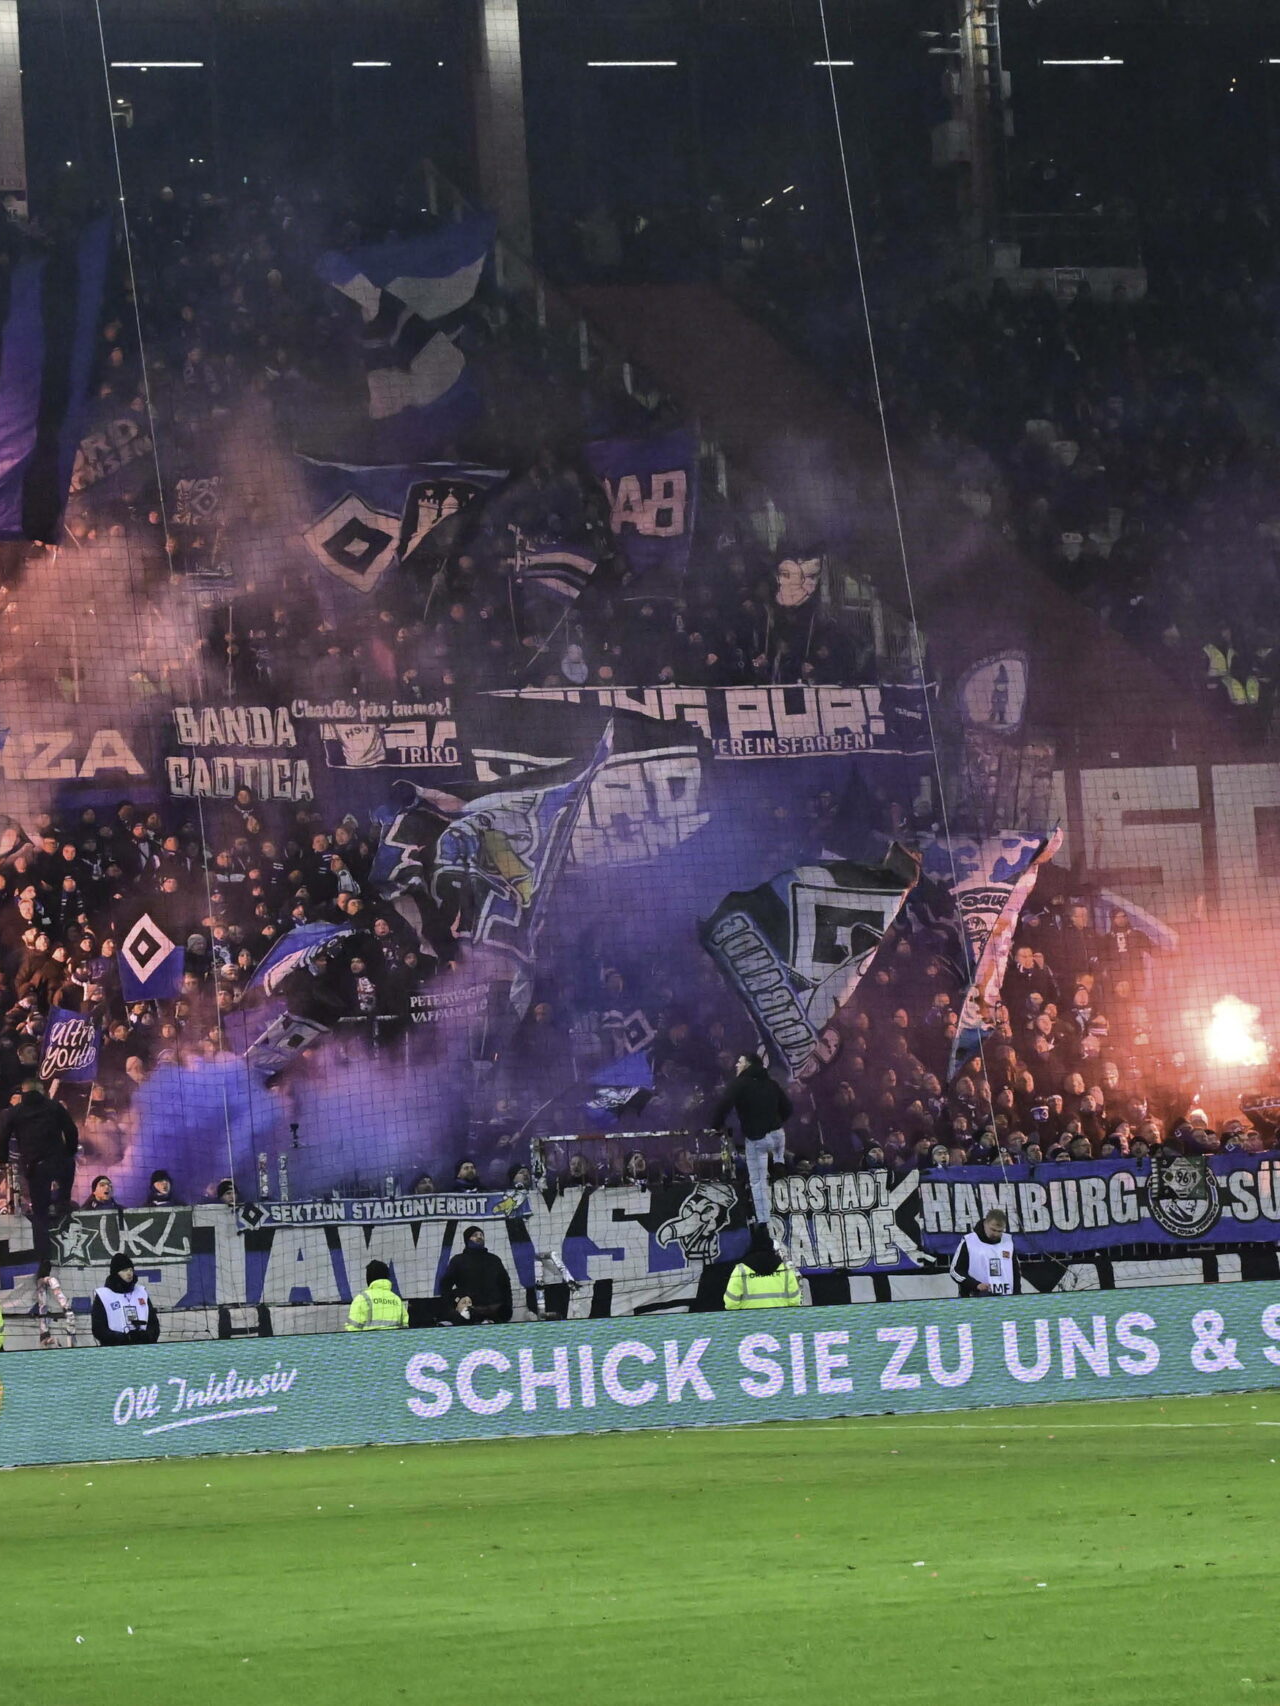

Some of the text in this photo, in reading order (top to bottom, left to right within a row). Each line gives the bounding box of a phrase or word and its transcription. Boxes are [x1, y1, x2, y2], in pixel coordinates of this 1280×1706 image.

[172, 706, 296, 748] BANDA
[271, 1196, 488, 1221] SEKTION STADIONVERBOT
[770, 1169, 891, 1212] ORSTADT
[921, 1171, 1141, 1235] HAMBURG
[404, 1337, 716, 1418] SCHICK
[737, 1330, 854, 1398] SIE
[876, 1322, 974, 1391] ZU
[1002, 1311, 1162, 1382] UNS
[1189, 1309, 1246, 1373] &
[113, 1361, 297, 1426] Oll Inklusiv
